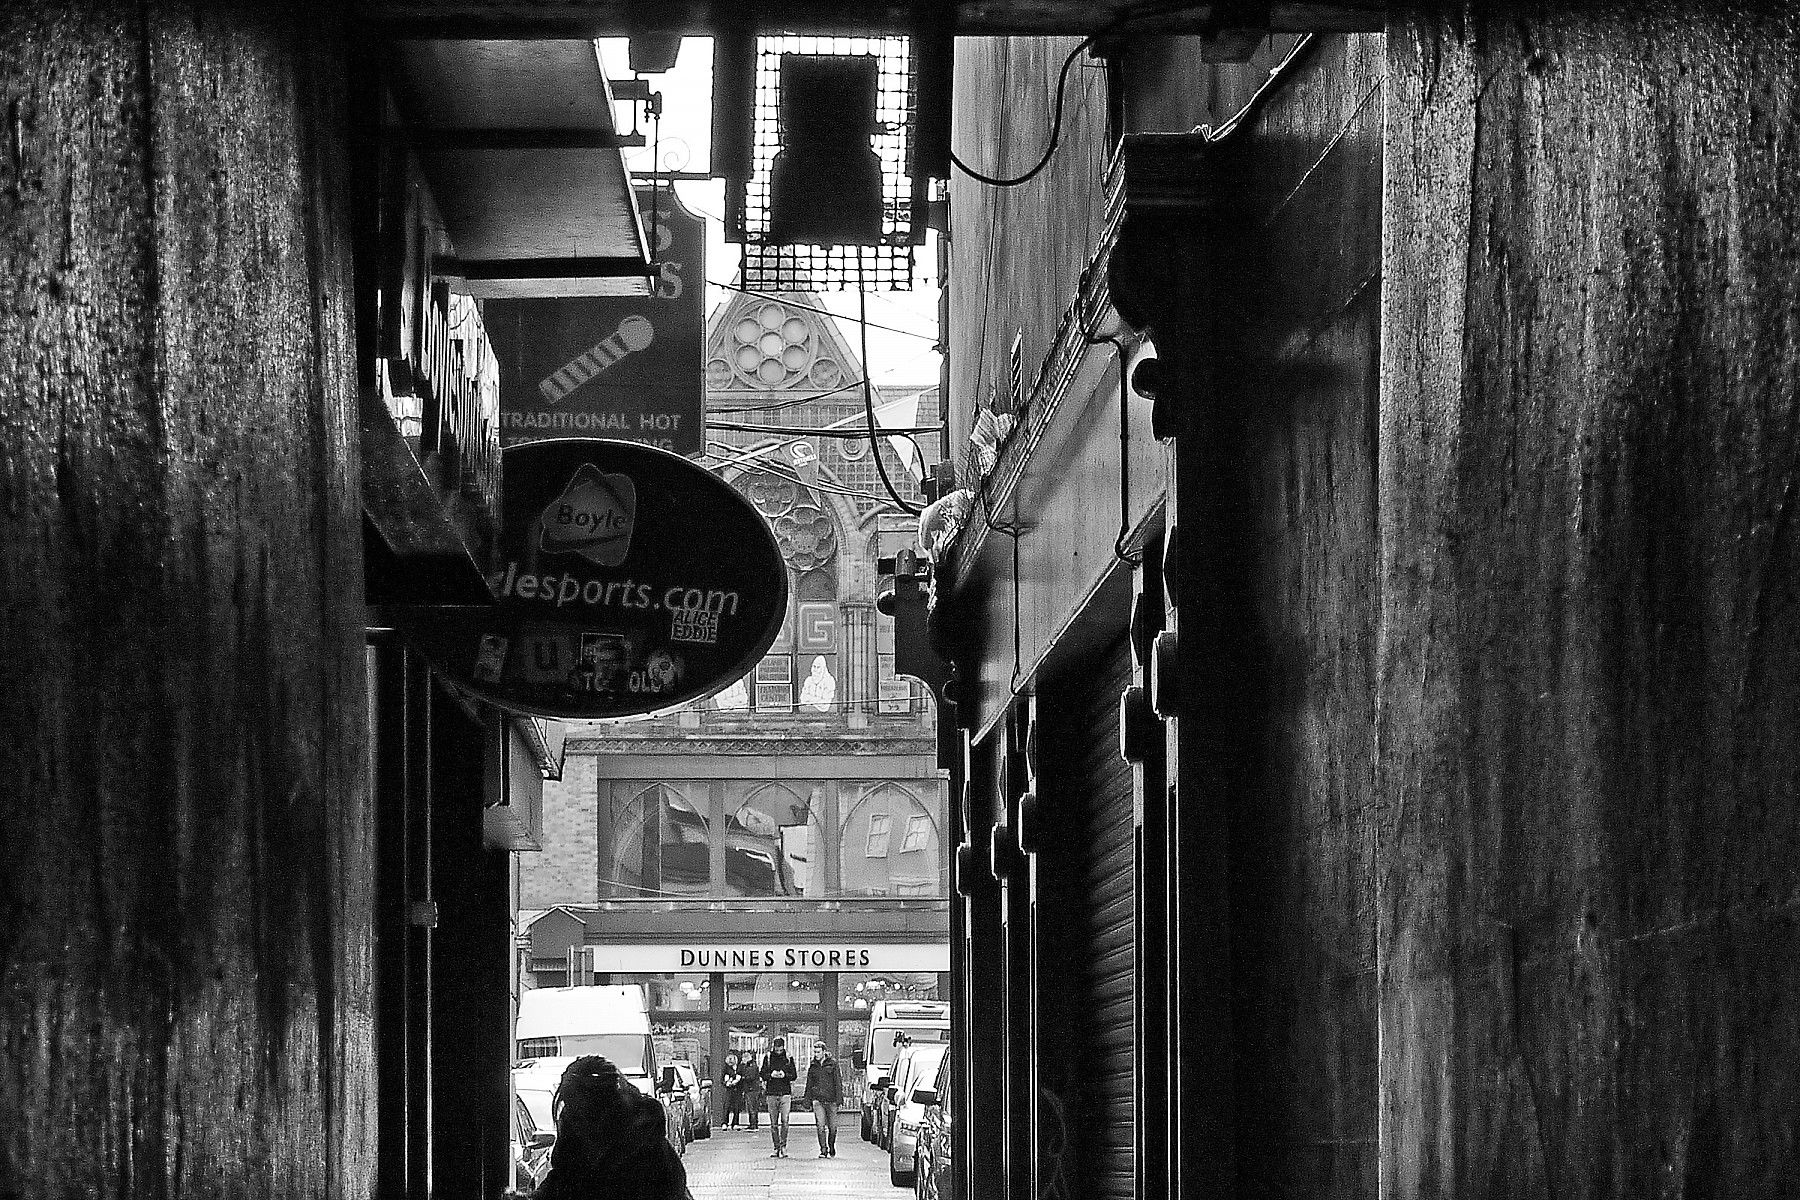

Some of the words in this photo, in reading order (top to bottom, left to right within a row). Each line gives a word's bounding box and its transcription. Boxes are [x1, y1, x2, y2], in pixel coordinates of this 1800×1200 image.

[501, 412, 630, 430] TRADITIONAL
[639, 413, 681, 430] HOT
[556, 503, 627, 536] Boyle
[501, 561, 738, 616] lesports.com
[680, 949, 774, 967] DUNNES
[784, 948, 870, 967] STORES
